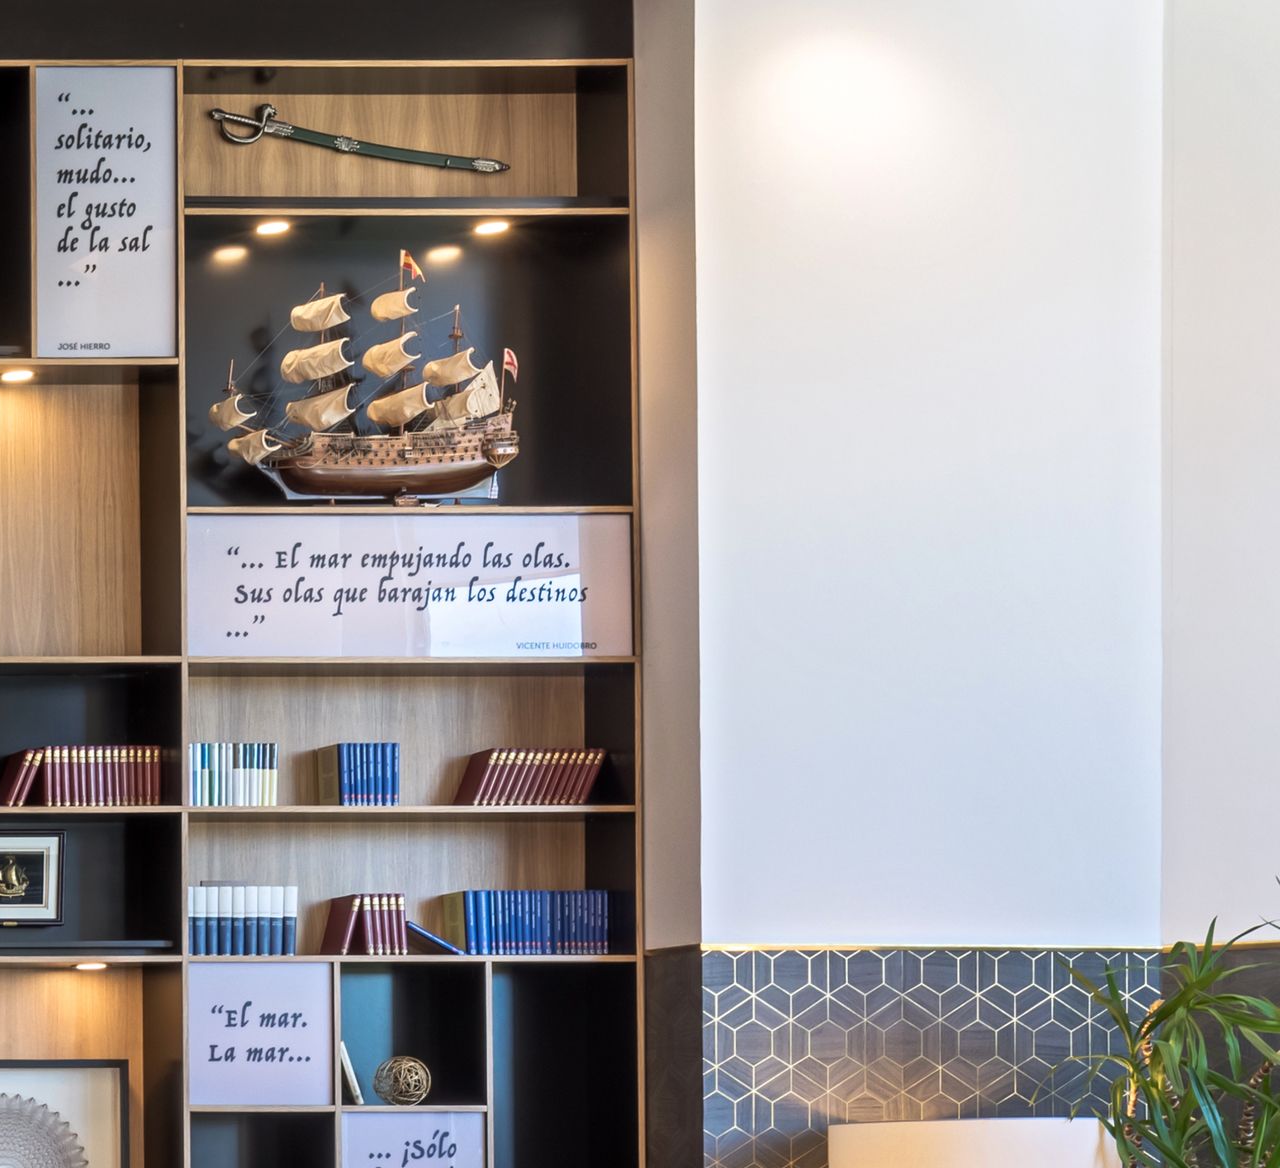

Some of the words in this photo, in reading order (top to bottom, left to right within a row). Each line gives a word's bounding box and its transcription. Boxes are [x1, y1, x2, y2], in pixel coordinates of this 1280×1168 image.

[55, 123, 151, 152] solitario,
[57, 157, 135, 184] mudo...
[57, 192, 78, 218] el
[81, 199, 136, 230] gusto
[57, 226, 78, 252] de
[89, 226, 109, 252] la
[118, 225, 153, 252] sal
[57, 340, 78, 351] JOSÉ
[80, 342, 111, 351] HIERRO
[276, 543, 302, 568] El
[310, 554, 352, 568] mar
[361, 542, 471, 579] empujando
[483, 542, 512, 568] las
[523, 542, 569, 568] olas.
[235, 585, 273, 603] Sus
[283, 577, 324, 602] olas
[333, 588, 367, 616] que
[378, 577, 456, 611] barajan
[468, 576, 496, 602] los
[506, 576, 588, 603] destinos
[516, 642, 551, 650] VICENTE
[552, 642, 598, 650] HUIDOBRO
[211, 1001, 252, 1027] “El
[260, 1013, 307, 1028] mar.
[208, 1045, 235, 1062] La
[247, 1047, 310, 1062] mar...
[402, 1130, 456, 1168] ¡Sólo
